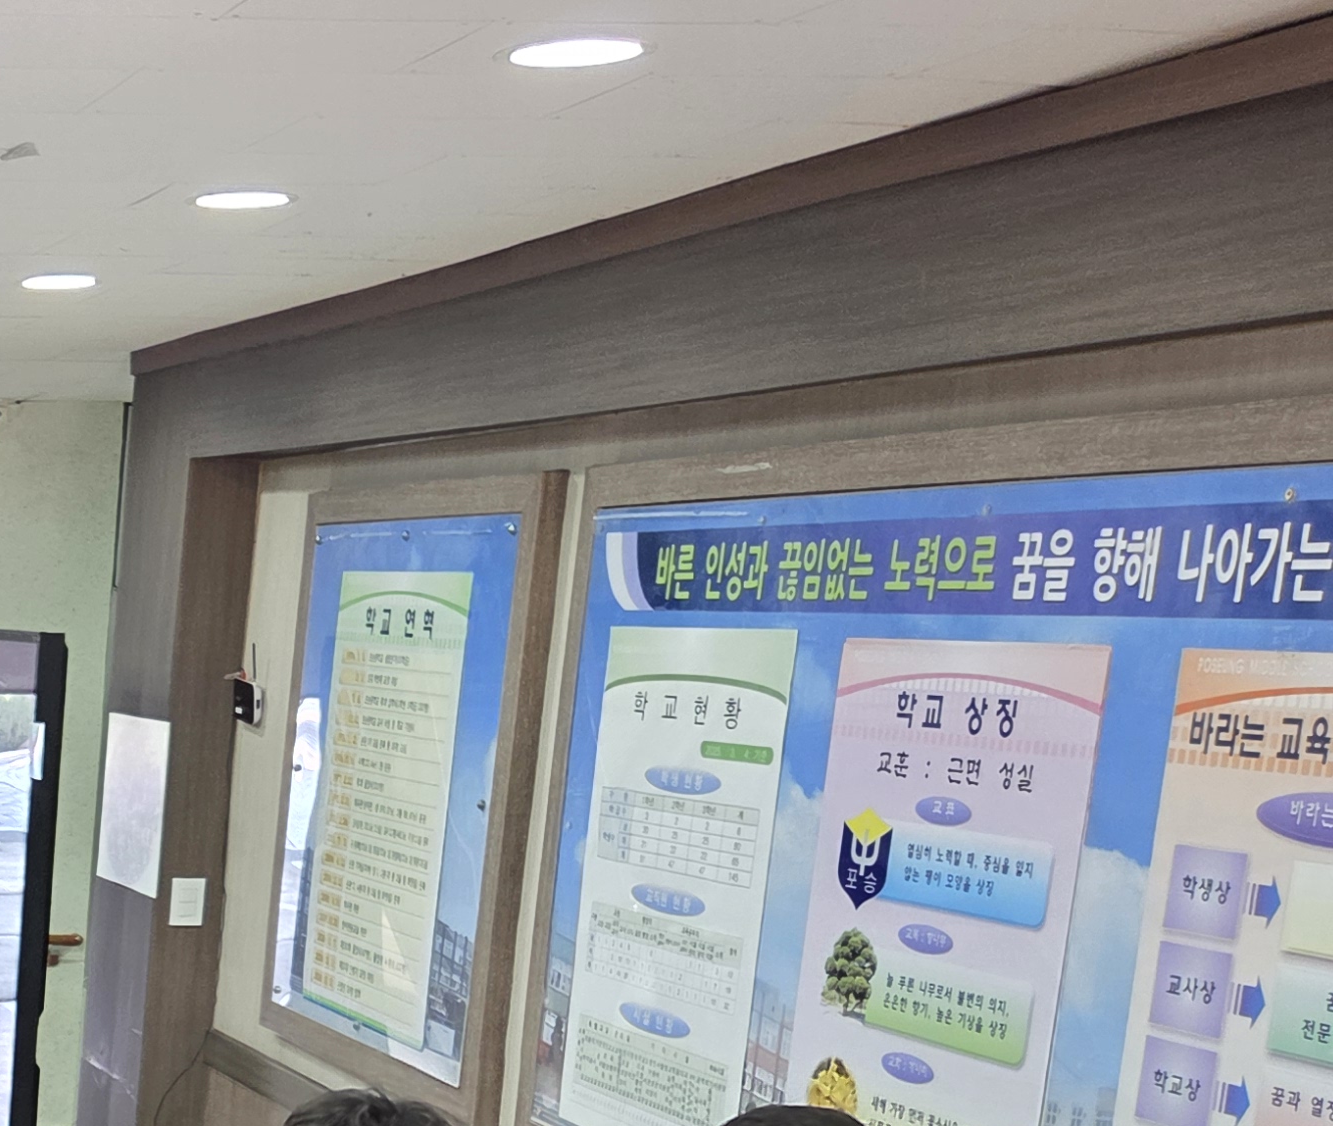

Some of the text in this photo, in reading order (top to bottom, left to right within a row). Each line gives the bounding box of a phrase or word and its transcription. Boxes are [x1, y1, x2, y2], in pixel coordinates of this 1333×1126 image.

[656, 520, 1332, 603] 바른 인성과 끊임없는 노력으로 꿈을 향해 나아가는
[365, 606, 435, 640] 학교 연혁
[634, 691, 741, 729] 학교 현황
[895, 691, 1019, 738] 학교 상징
[1189, 711, 1331, 765] 바라는 교육
[877, 751, 909, 781] 교훈
[947, 757, 982, 786] 근면
[1000, 761, 1034, 792] 성실
[932, 800, 955, 816] 교표
[1290, 801, 1333, 828] 바라는
[907, 843, 932, 861] 열심히
[936, 846, 962, 866] 노력할
[983, 855, 1010, 874] 중심을
[1015, 860, 1034, 878] 잃지
[845, 868, 877, 894] 포승
[904, 866, 995, 897] 않는 팽이 모양을 상징
[1182, 875, 1231, 904] 학생상
[673, 894, 692, 913] 현황
[886, 972, 894, 988] 늘
[898, 975, 915, 993] 푸른
[920, 980, 953, 1002] 나무로서
[957, 988, 984, 1008] 불변의
[1166, 975, 1216, 1005] 교사상
[883, 993, 908, 1013] 은은한
[936, 1006, 953, 1025] 높은
[957, 1011, 984, 1034] 기상을
[988, 1020, 1008, 1040] 상징
[1301, 1019, 1331, 1044] 전문
[1154, 1069, 1201, 1101] 학교상
[1271, 1087, 1301, 1111] 꿈과
[890, 1101, 905, 1120] 가장
[908, 1107, 926, 1126] 먼저
